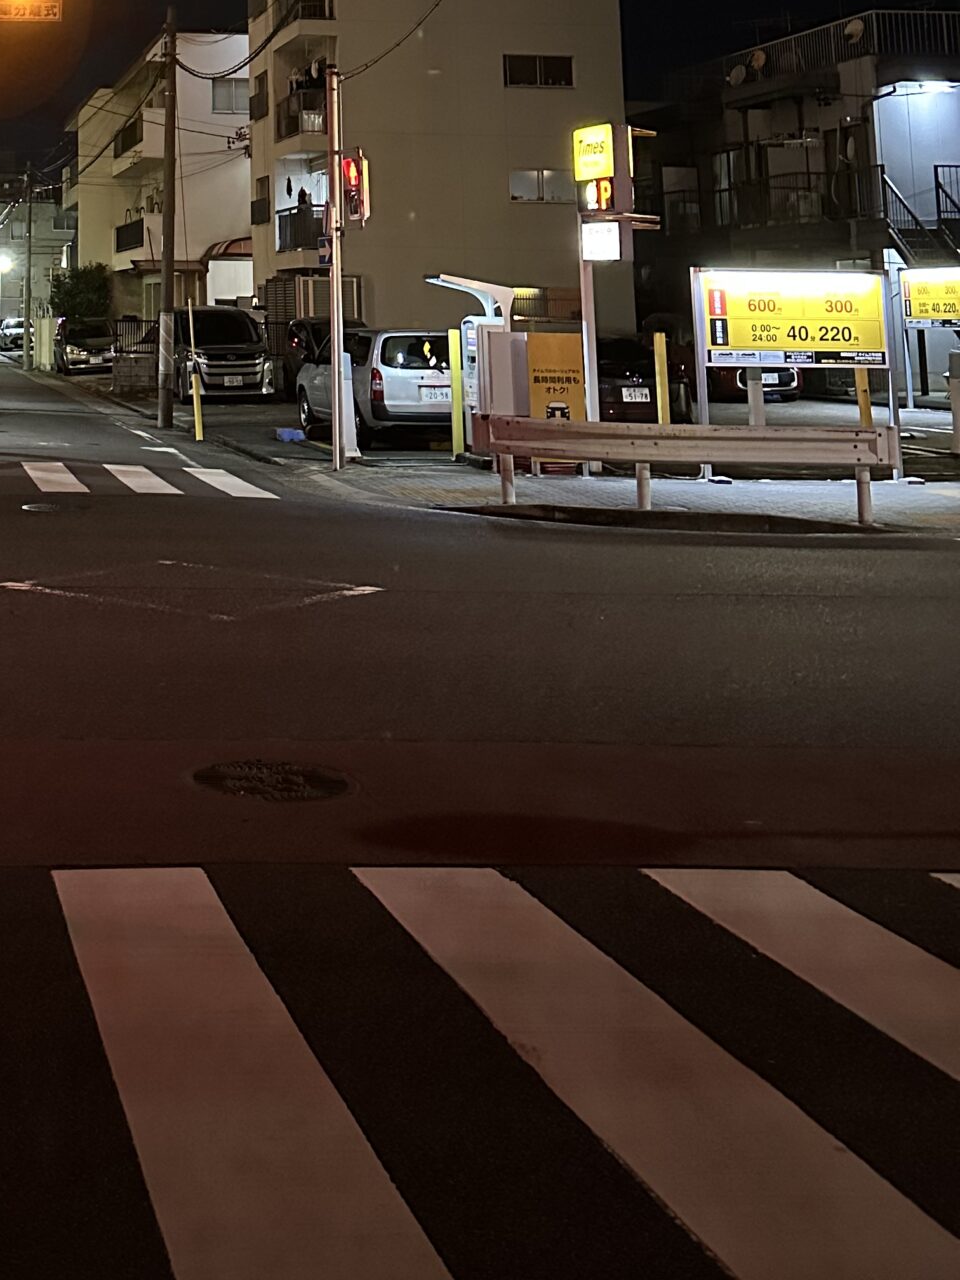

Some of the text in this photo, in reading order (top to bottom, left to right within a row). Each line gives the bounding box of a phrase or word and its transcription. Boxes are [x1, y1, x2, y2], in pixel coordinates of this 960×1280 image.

[578, 140, 605, 157] Times
[600, 179, 612, 210] P
[751, 333, 777, 342] 24:00
